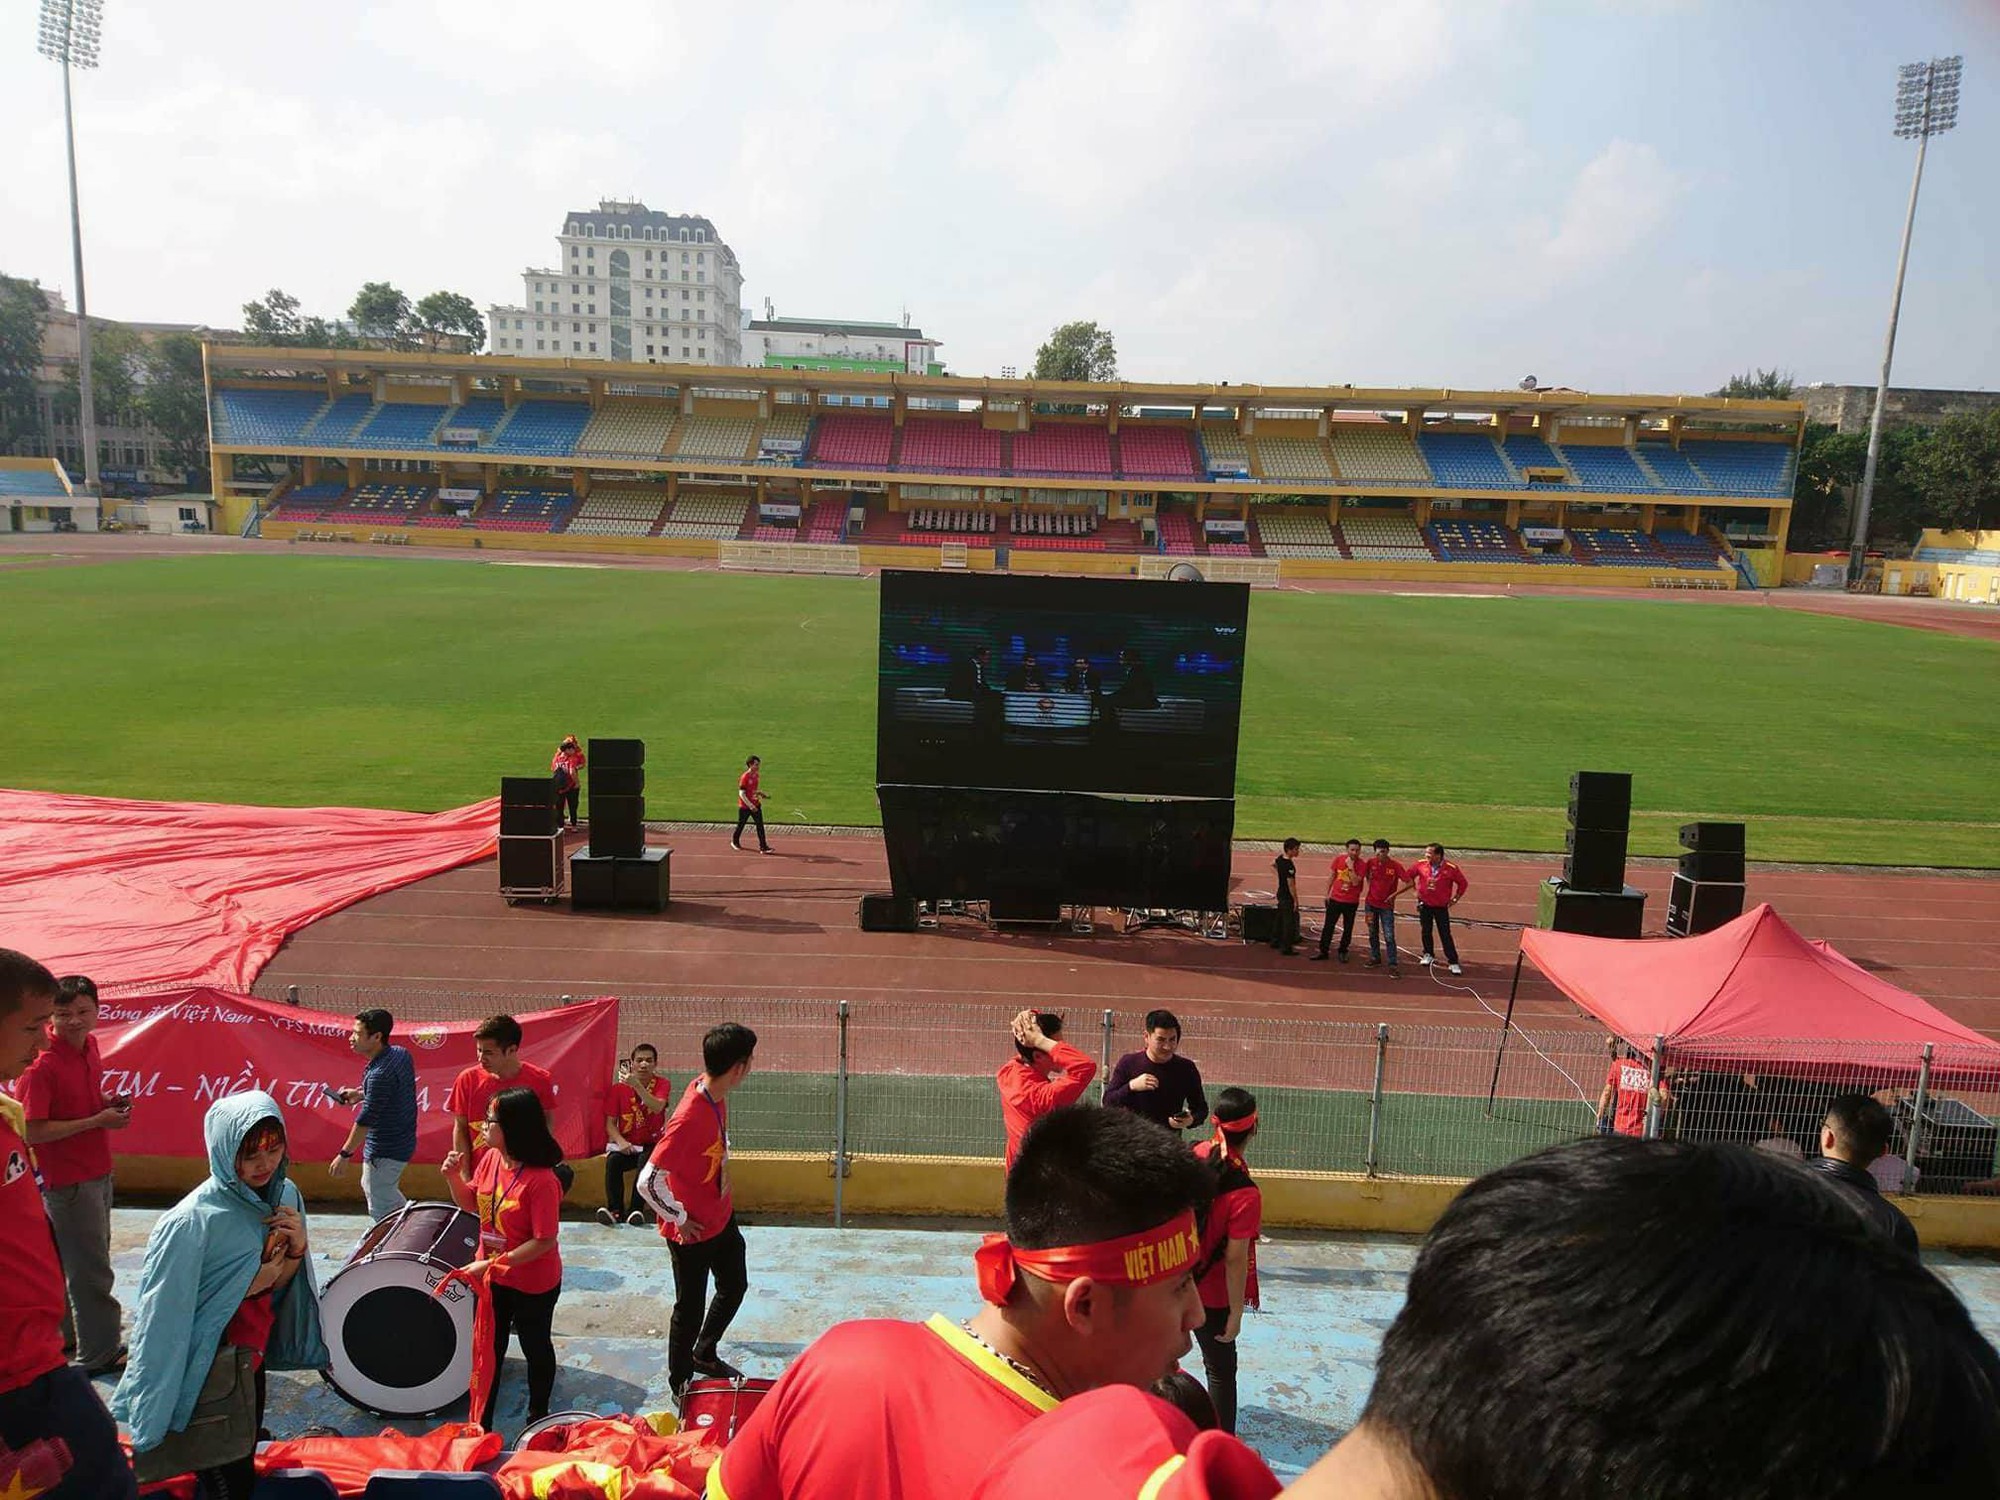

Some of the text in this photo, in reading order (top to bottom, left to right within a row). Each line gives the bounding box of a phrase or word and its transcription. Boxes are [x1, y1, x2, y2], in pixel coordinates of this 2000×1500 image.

[172, 1004, 213, 1024] Việt
[213, 1006, 254, 1024] Nam
[1124, 1231, 1189, 1285] VIỆT NAM
